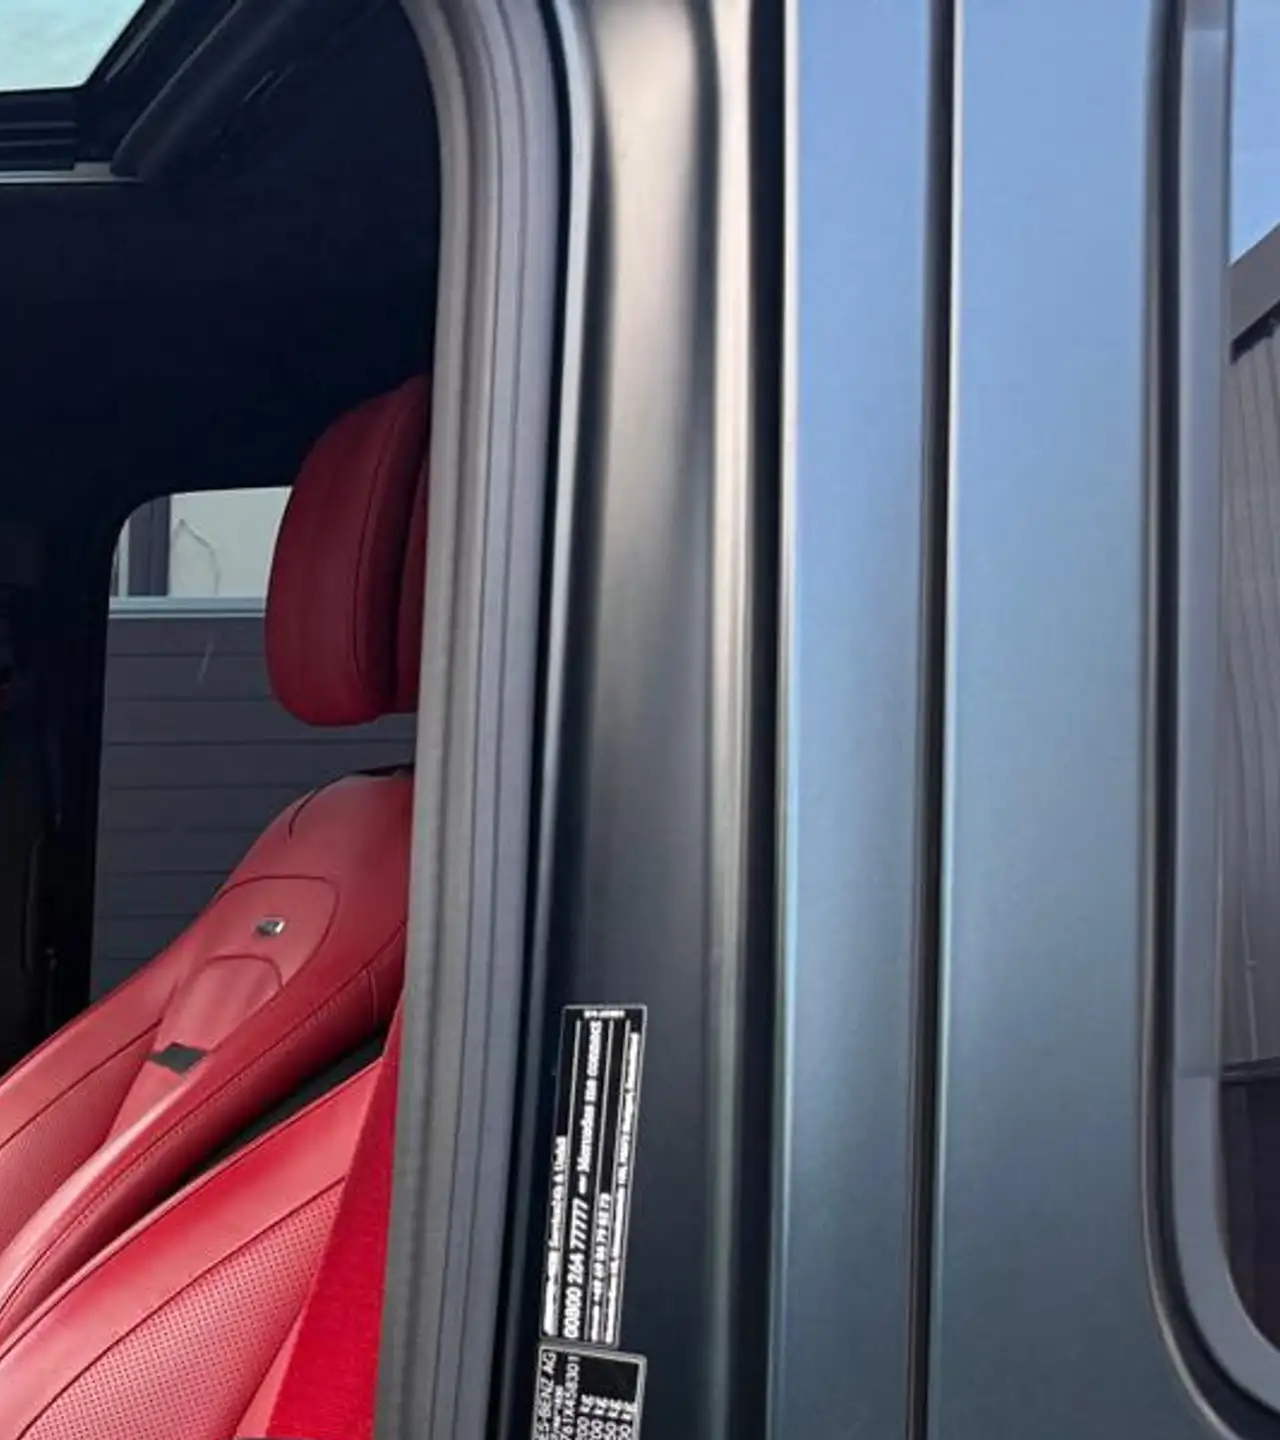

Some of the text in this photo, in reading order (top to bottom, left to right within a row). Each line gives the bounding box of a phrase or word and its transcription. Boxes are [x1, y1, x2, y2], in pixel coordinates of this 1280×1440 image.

[569, 1197, 589, 1250] 77777
[567, 1253, 585, 1285] 264
[563, 1286, 582, 1339] 00800
[542, 1351, 557, 1375] AG
[580, 1394, 594, 1414] kg
[592, 1396, 607, 1416] kg
[605, 1398, 621, 1418] kg
